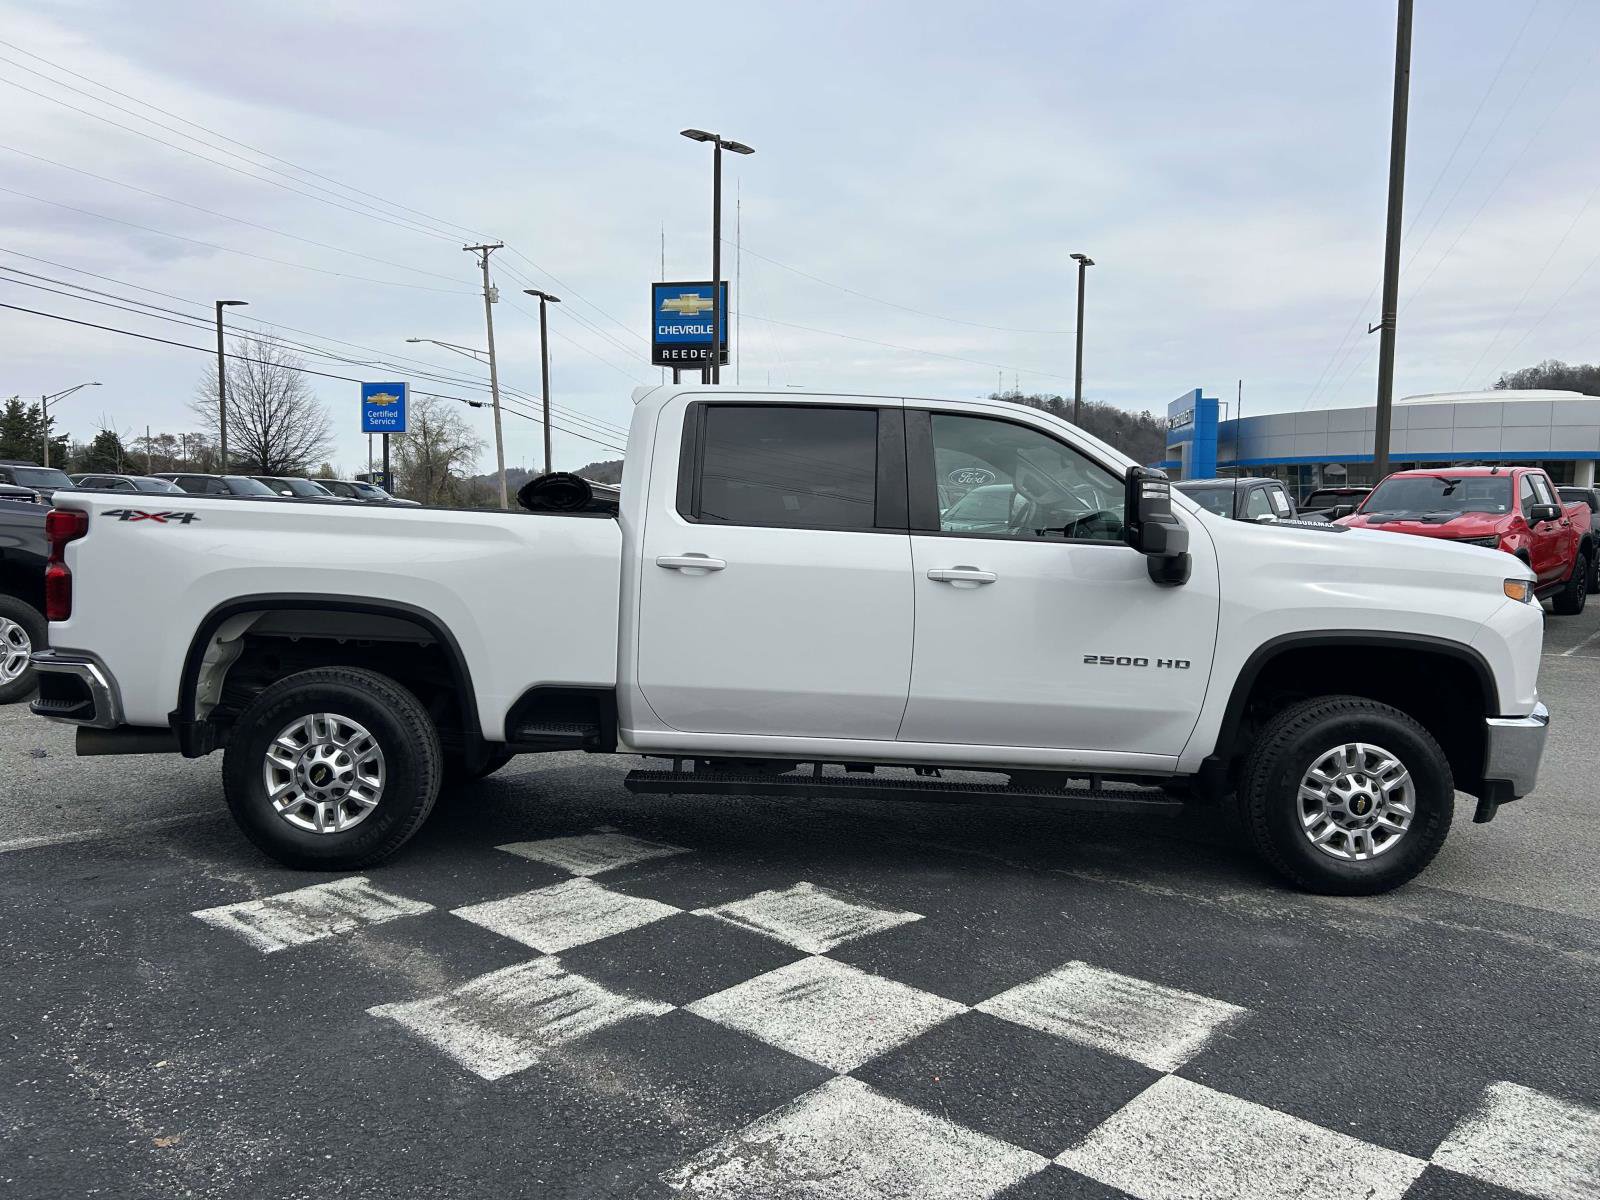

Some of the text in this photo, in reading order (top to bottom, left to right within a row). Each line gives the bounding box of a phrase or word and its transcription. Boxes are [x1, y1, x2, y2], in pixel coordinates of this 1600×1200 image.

[658, 324, 714, 335] CHEVROLE
[367, 410, 398, 418] Certified
[369, 417, 396, 425] Service
[1083, 655, 1191, 670] 2500 HD
